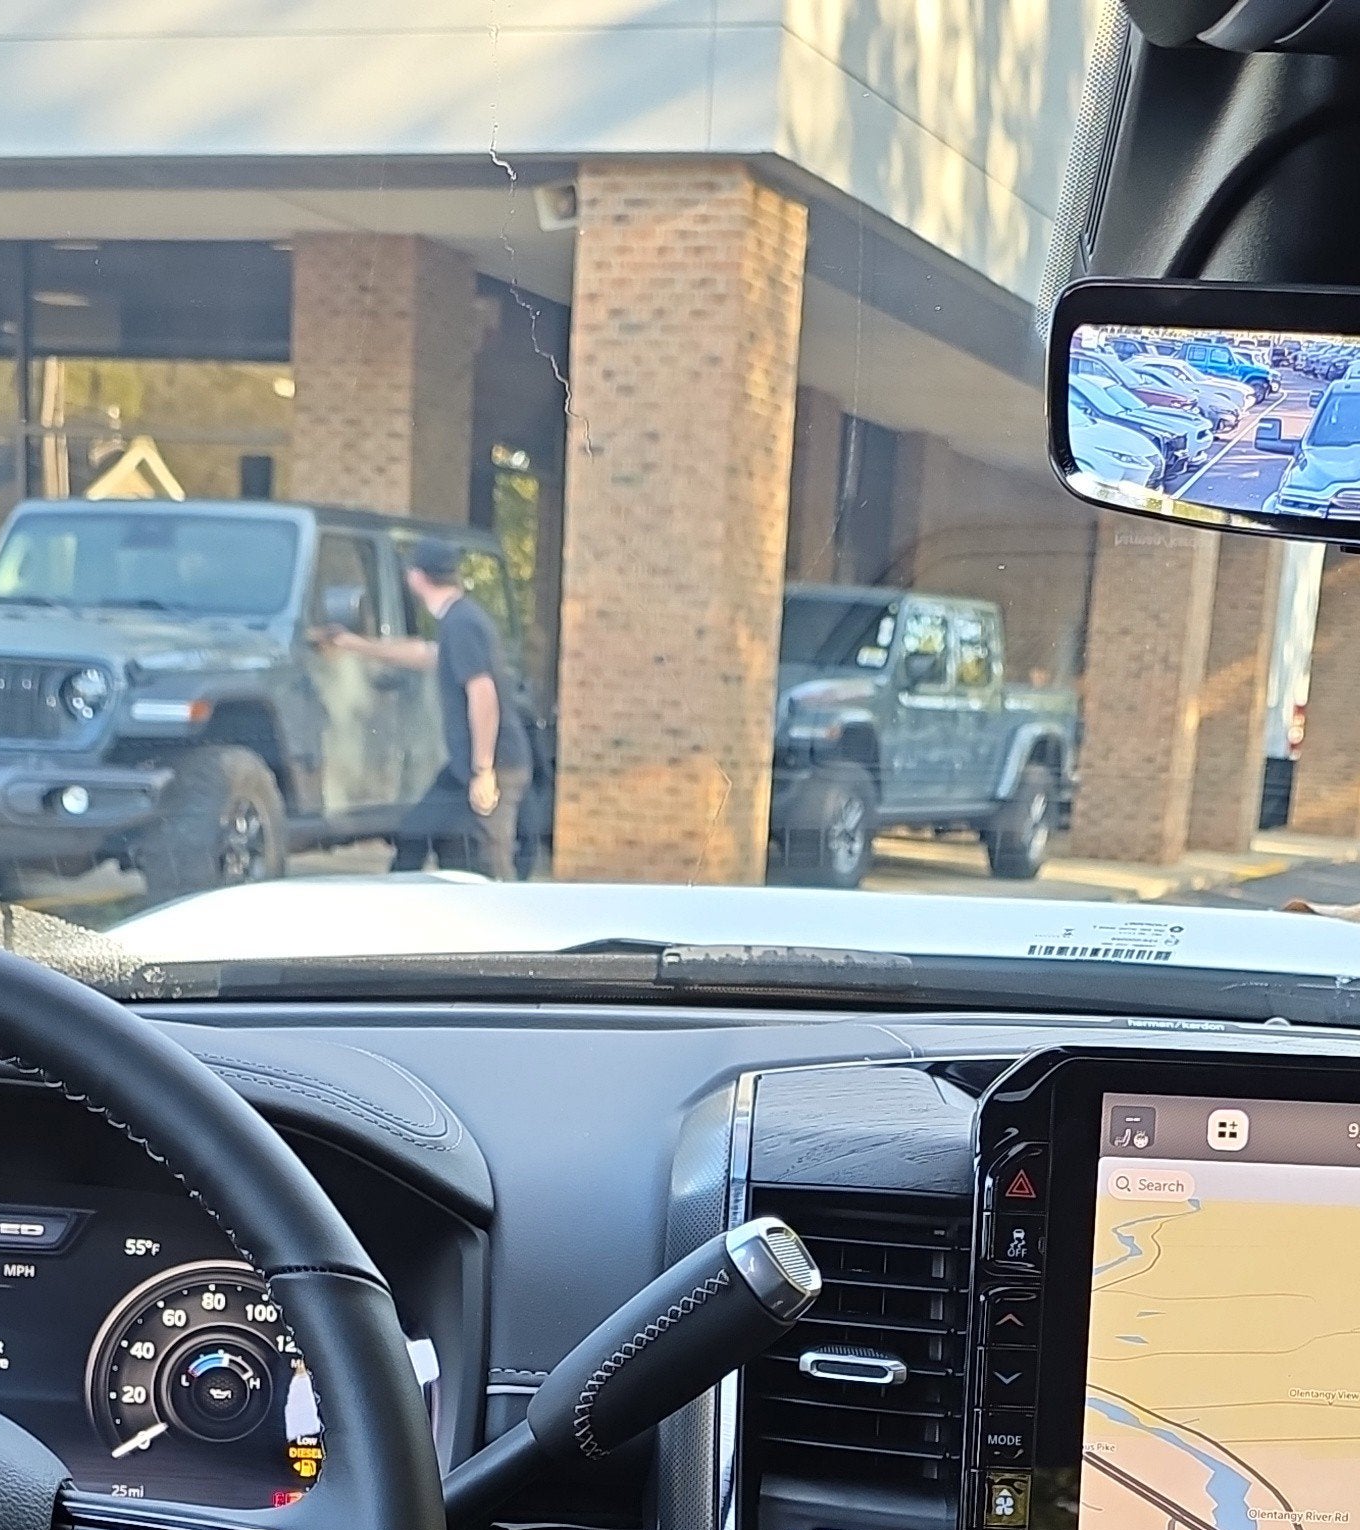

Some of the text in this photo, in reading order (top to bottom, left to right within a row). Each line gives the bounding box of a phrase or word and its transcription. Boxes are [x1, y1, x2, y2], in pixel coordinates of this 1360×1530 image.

[1138, 1178, 1185, 1193] Search
[123, 1237, 161, 1257] 55°F
[1006, 1248, 1028, 1259] OFF
[2, 1263, 36, 1279] MPH
[201, 1292, 227, 1311] 80
[161, 1309, 187, 1327] 60
[245, 1303, 278, 1323] 100
[129, 1341, 156, 1360] 40
[180, 1374, 191, 1387] L
[248, 1377, 262, 1390] H
[120, 1385, 147, 1404] 20
[1289, 1388, 1336, 1401] Olentangy
[1337, 1389, 1359, 1400] View
[986, 1434, 1023, 1446] MODE
[1098, 1442, 1116, 1453] Pike
[288, 1447, 323, 1460] DIESEL
[1248, 1509, 1349, 1525] Olentangy River Rd
